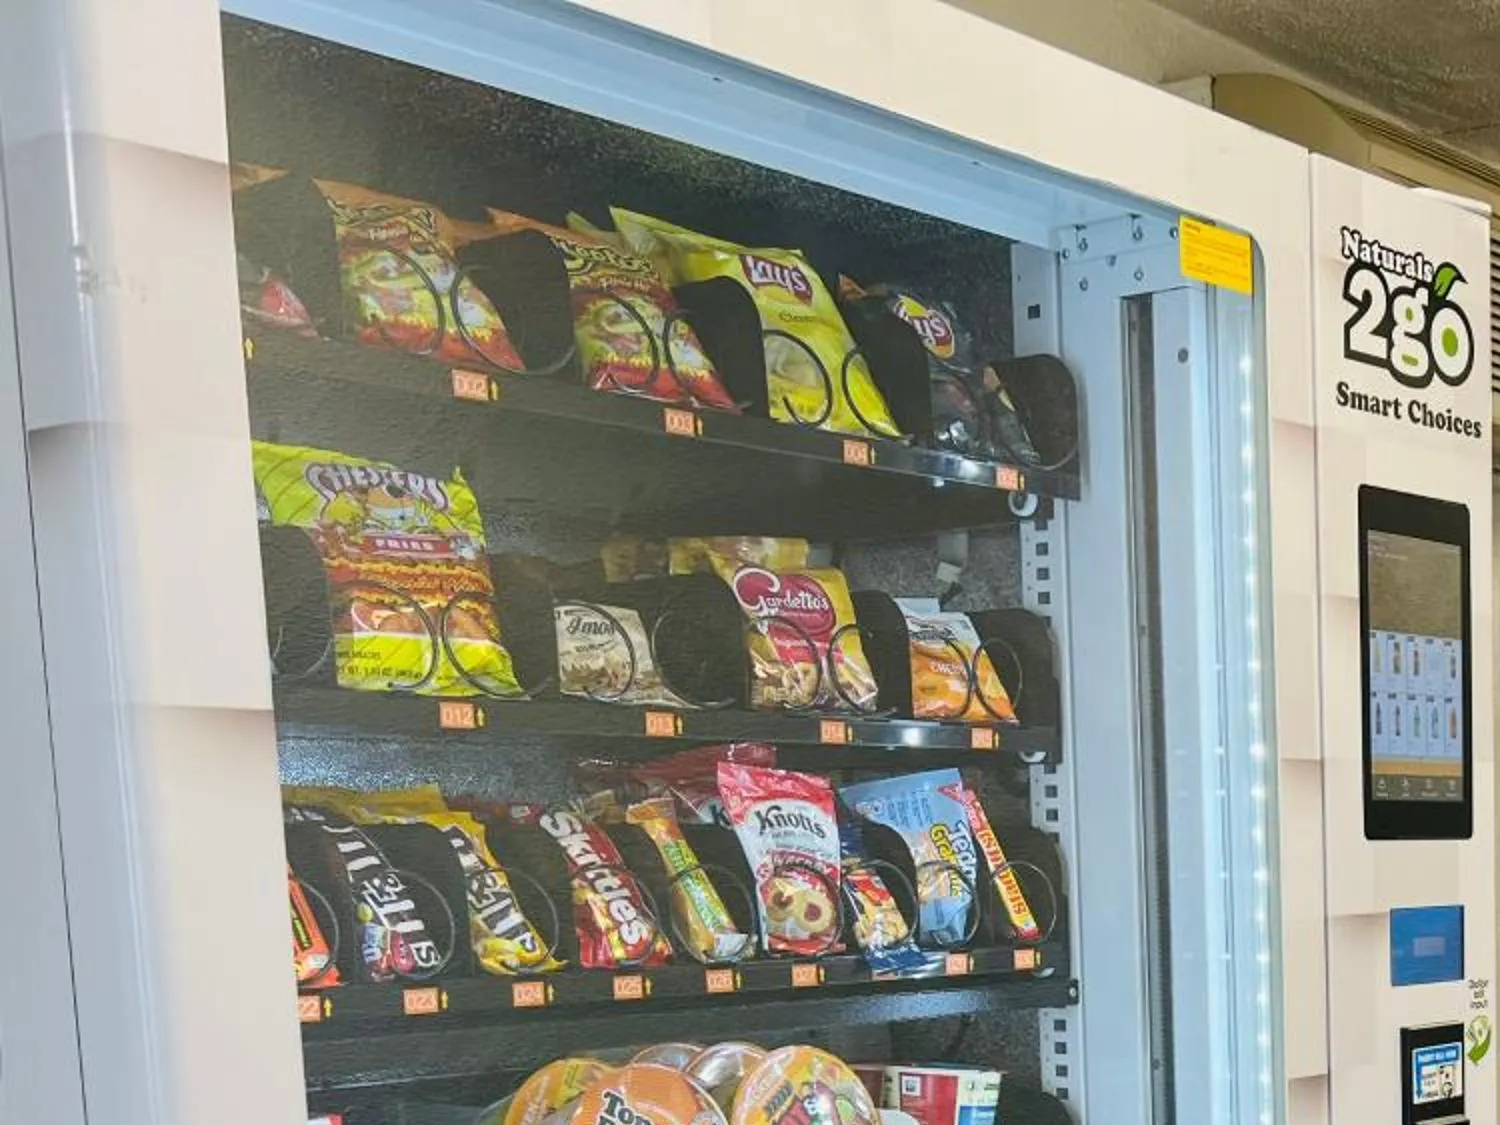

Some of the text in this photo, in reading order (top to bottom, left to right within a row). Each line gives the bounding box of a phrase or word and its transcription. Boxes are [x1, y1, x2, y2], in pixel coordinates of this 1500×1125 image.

[746, 254, 811, 297] Lay's
[1339, 226, 1435, 284] Naturals
[1336, 381, 1483, 440] Smart Choices
[539, 811, 648, 946] Skittles
